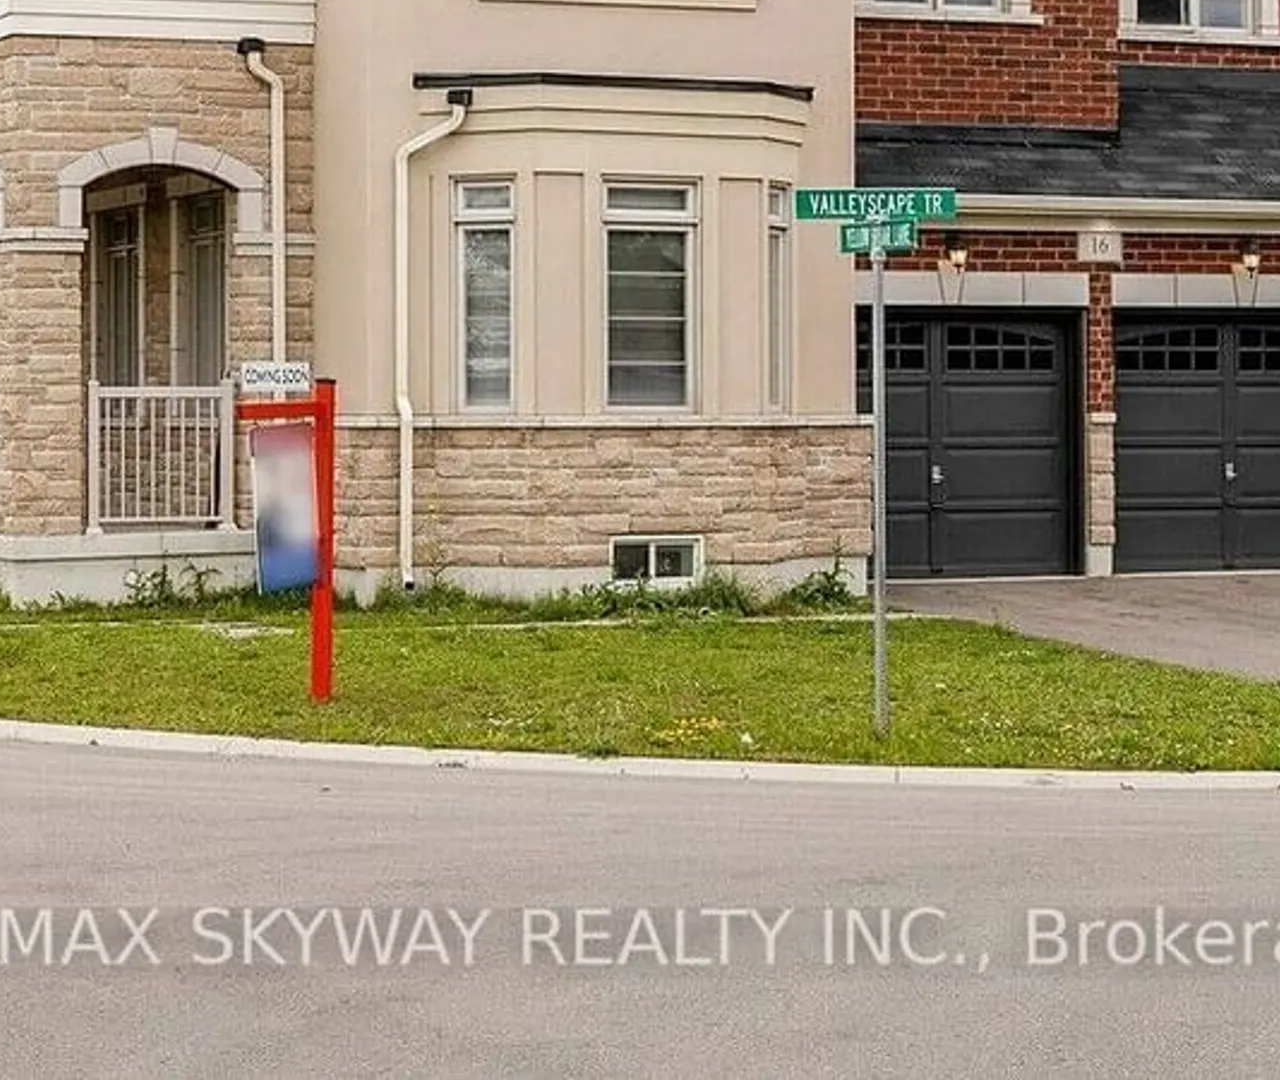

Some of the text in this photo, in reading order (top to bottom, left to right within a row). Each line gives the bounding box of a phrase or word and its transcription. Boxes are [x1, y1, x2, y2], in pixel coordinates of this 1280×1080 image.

[809, 193, 944, 216] VALLEYSCAPE TR
[1091, 236, 1110, 255] 16
[245, 368, 308, 384] COMING SOON
